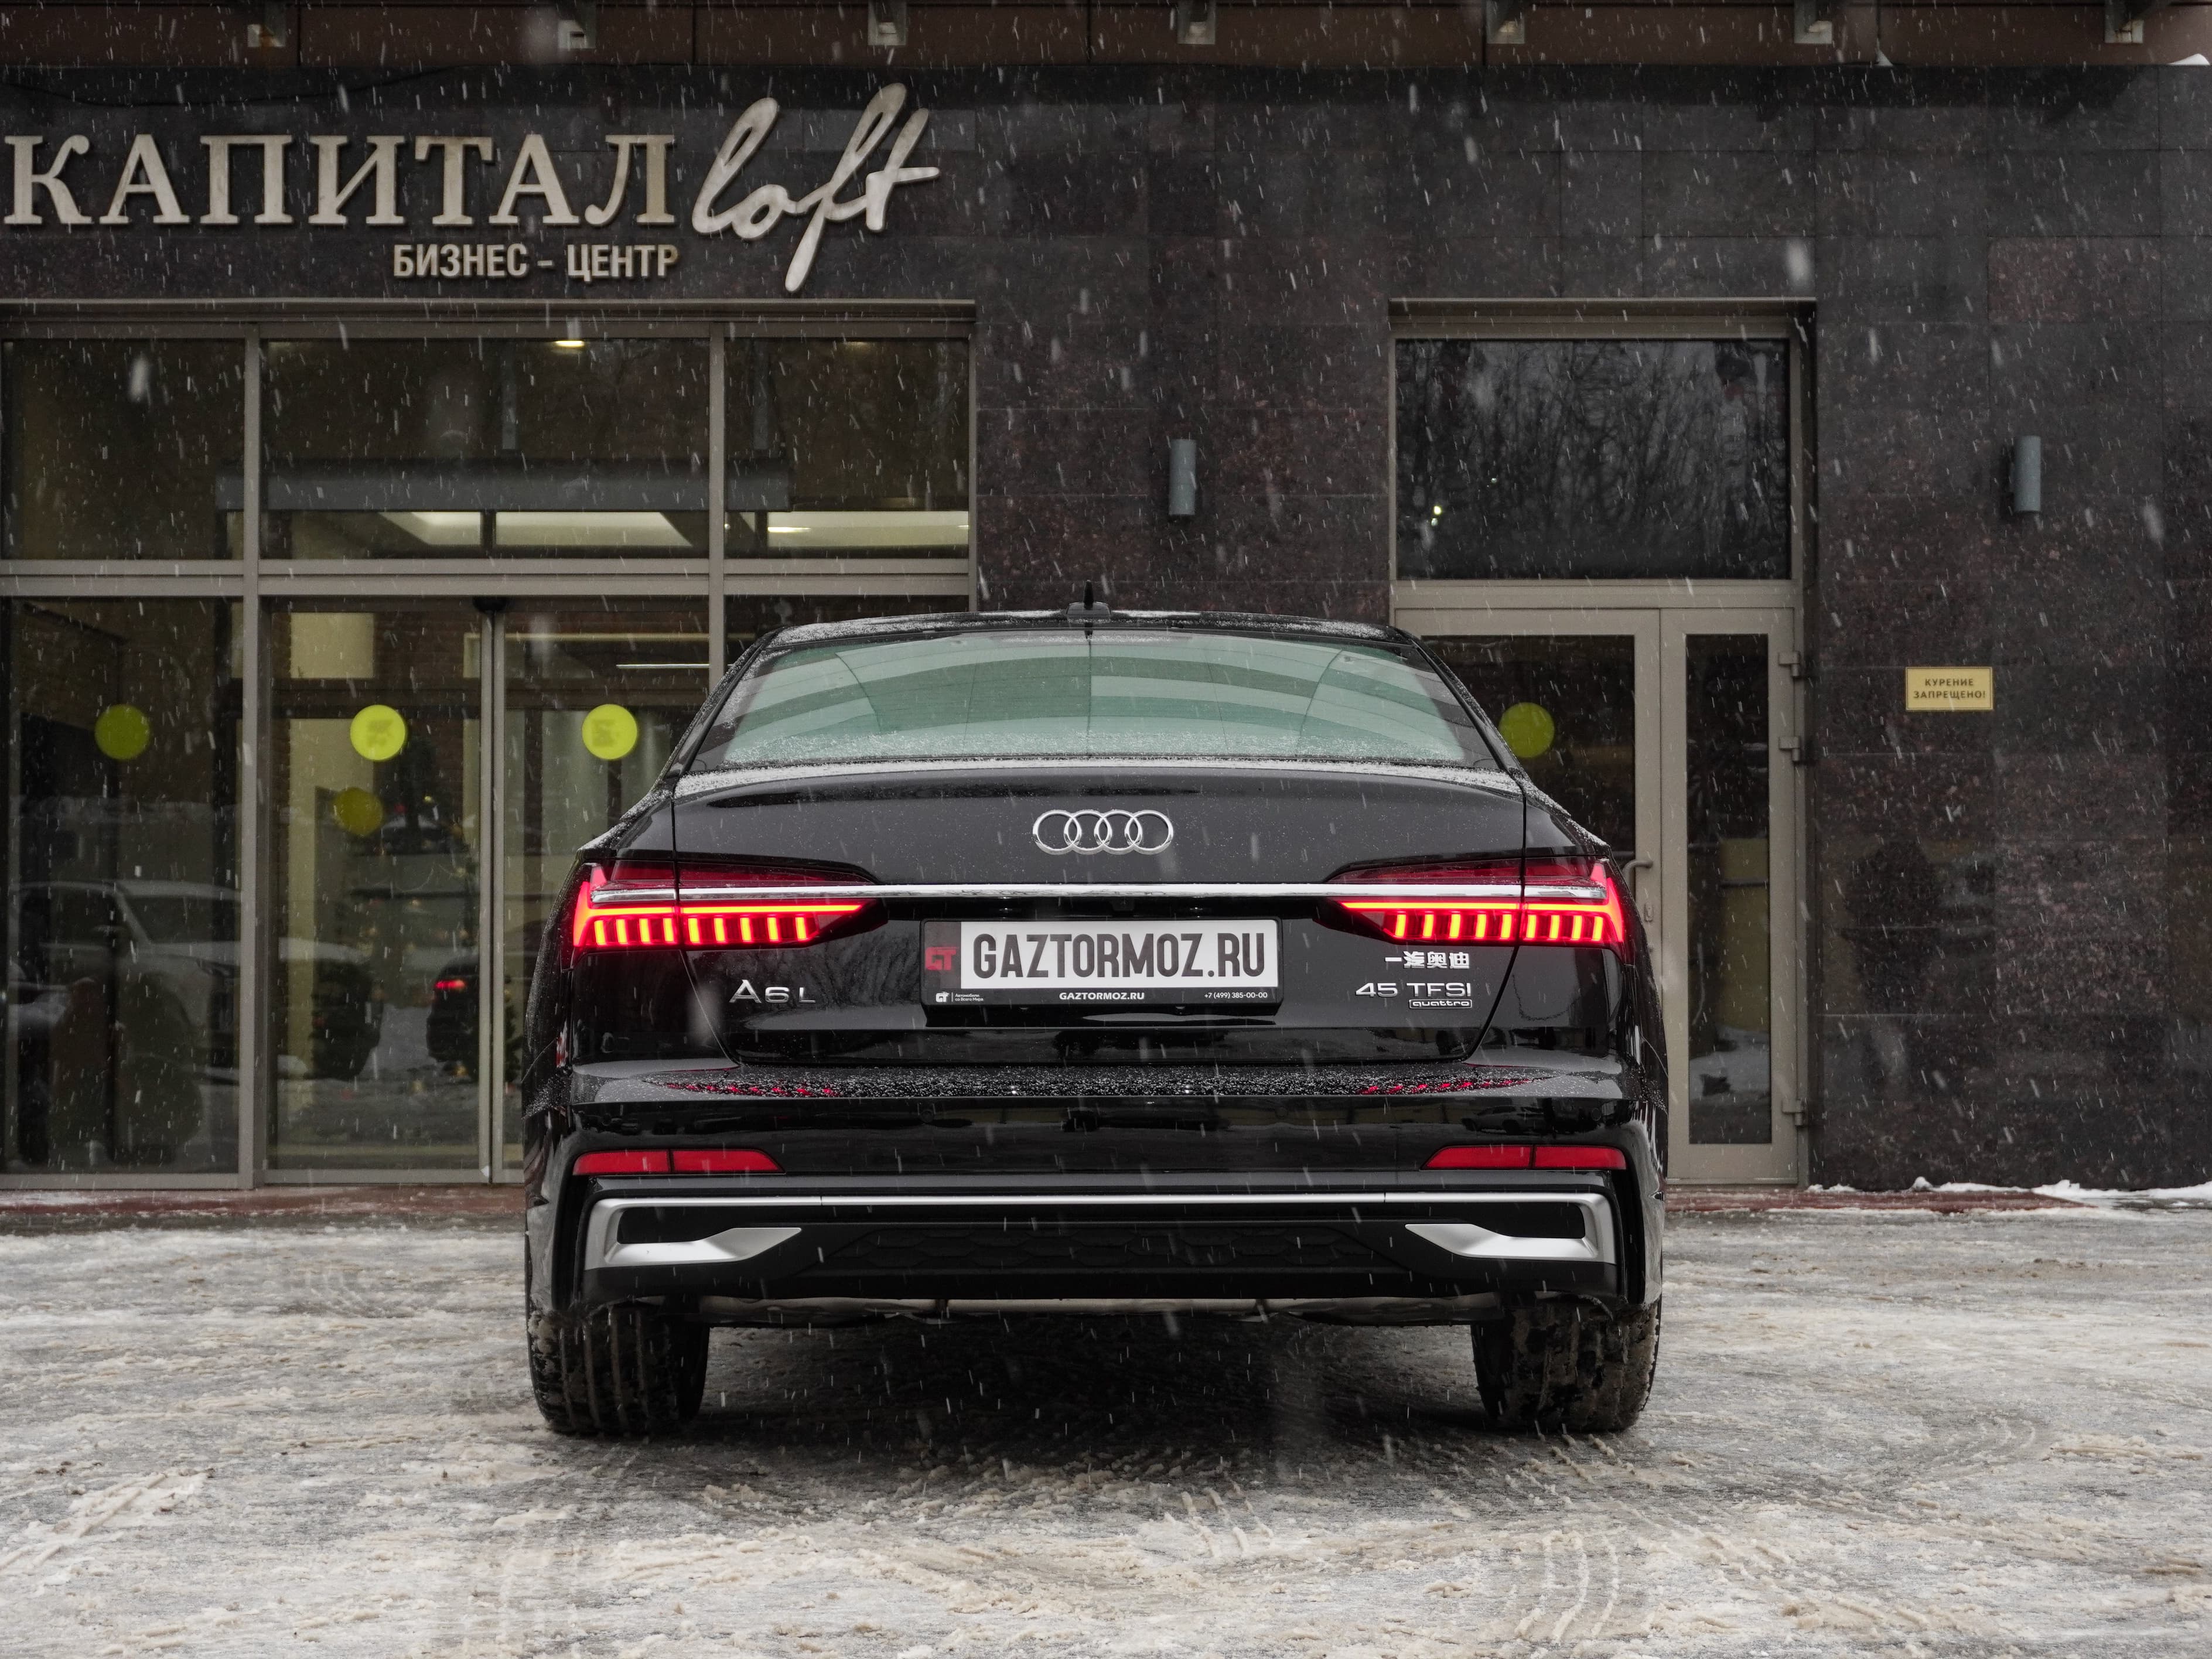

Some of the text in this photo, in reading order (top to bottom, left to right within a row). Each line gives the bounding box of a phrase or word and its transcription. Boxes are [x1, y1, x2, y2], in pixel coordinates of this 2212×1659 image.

[4, 134, 675, 227] КАПИТАЛ
[691, 82, 941, 293] loft
[393, 243, 528, 278] БИЗНЕС
[567, 244, 679, 282] ЦЕНТР
[1913, 691, 1986, 699] ЗАПРЕЩЕНО!
[973, 933, 1265, 978] GAZTORMOZ.RU
[1384, 951, 1470, 969] 一汽奥迪
[1355, 982, 1471, 997] 45 TFSI
[1412, 999, 1470, 1008] quattro
